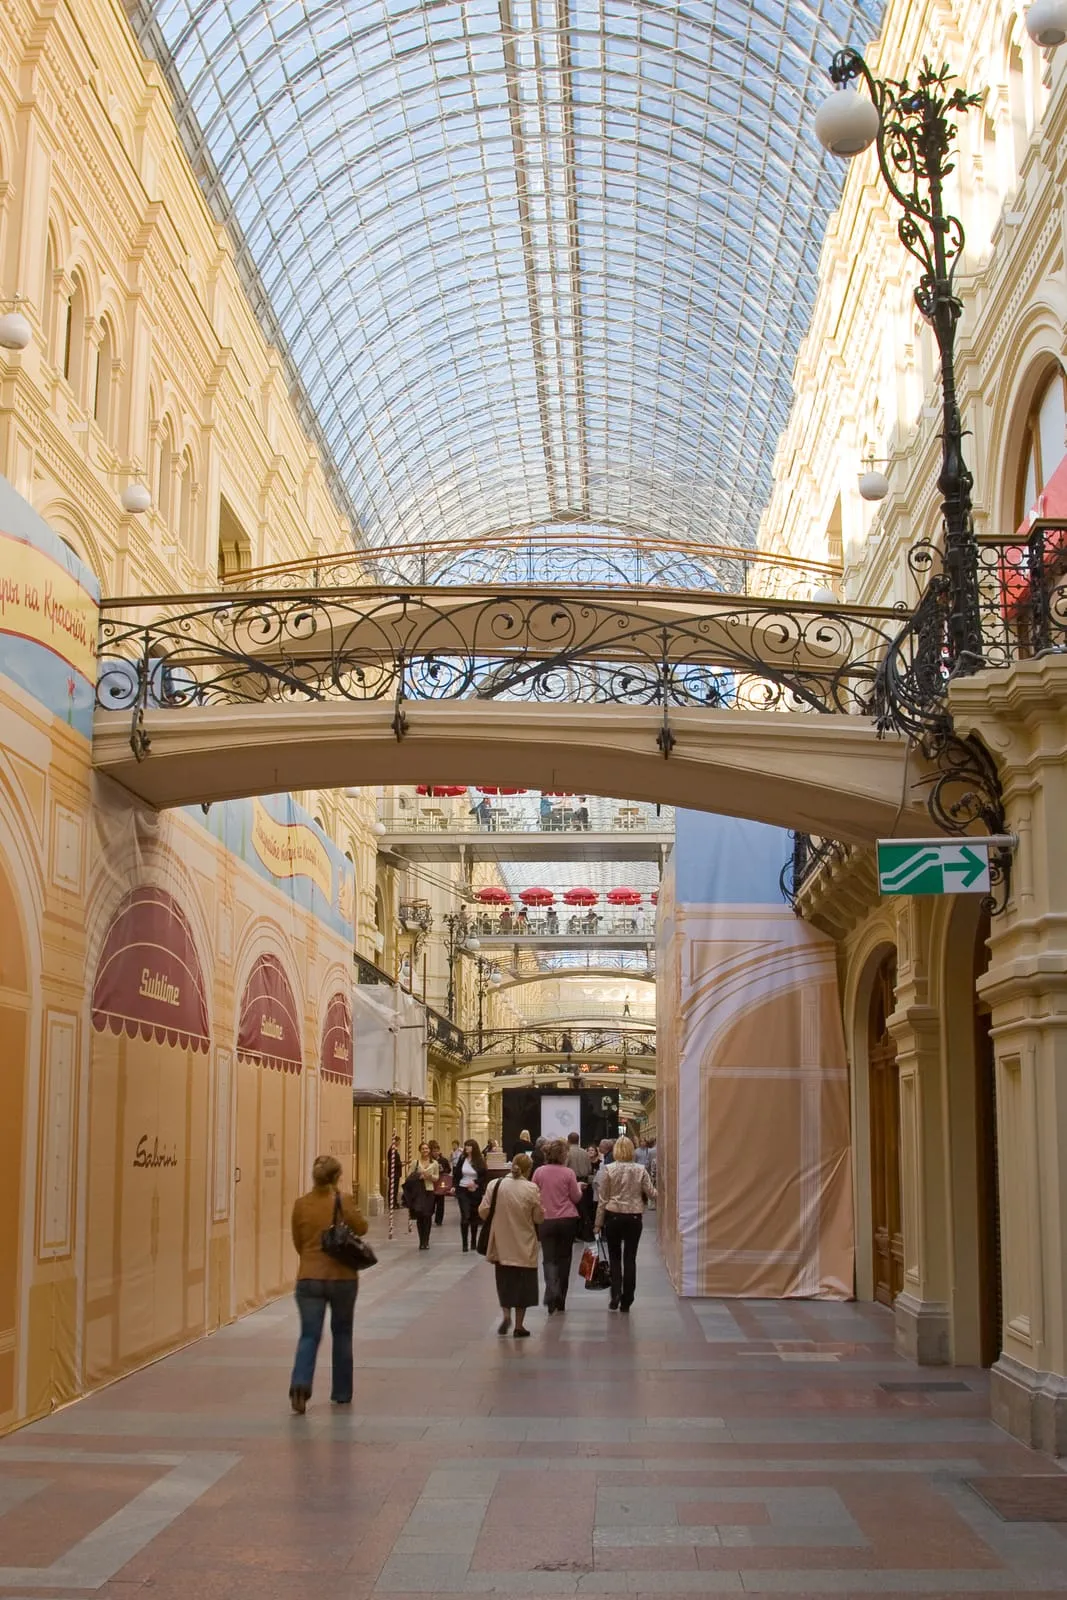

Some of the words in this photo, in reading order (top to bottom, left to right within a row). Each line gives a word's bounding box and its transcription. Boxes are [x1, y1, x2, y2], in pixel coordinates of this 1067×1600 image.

[24, 583, 40, 612] на
[44, 578, 86, 646] Красной
[139, 967, 180, 1006] Sublime
[133, 1134, 178, 1168] Salvini
